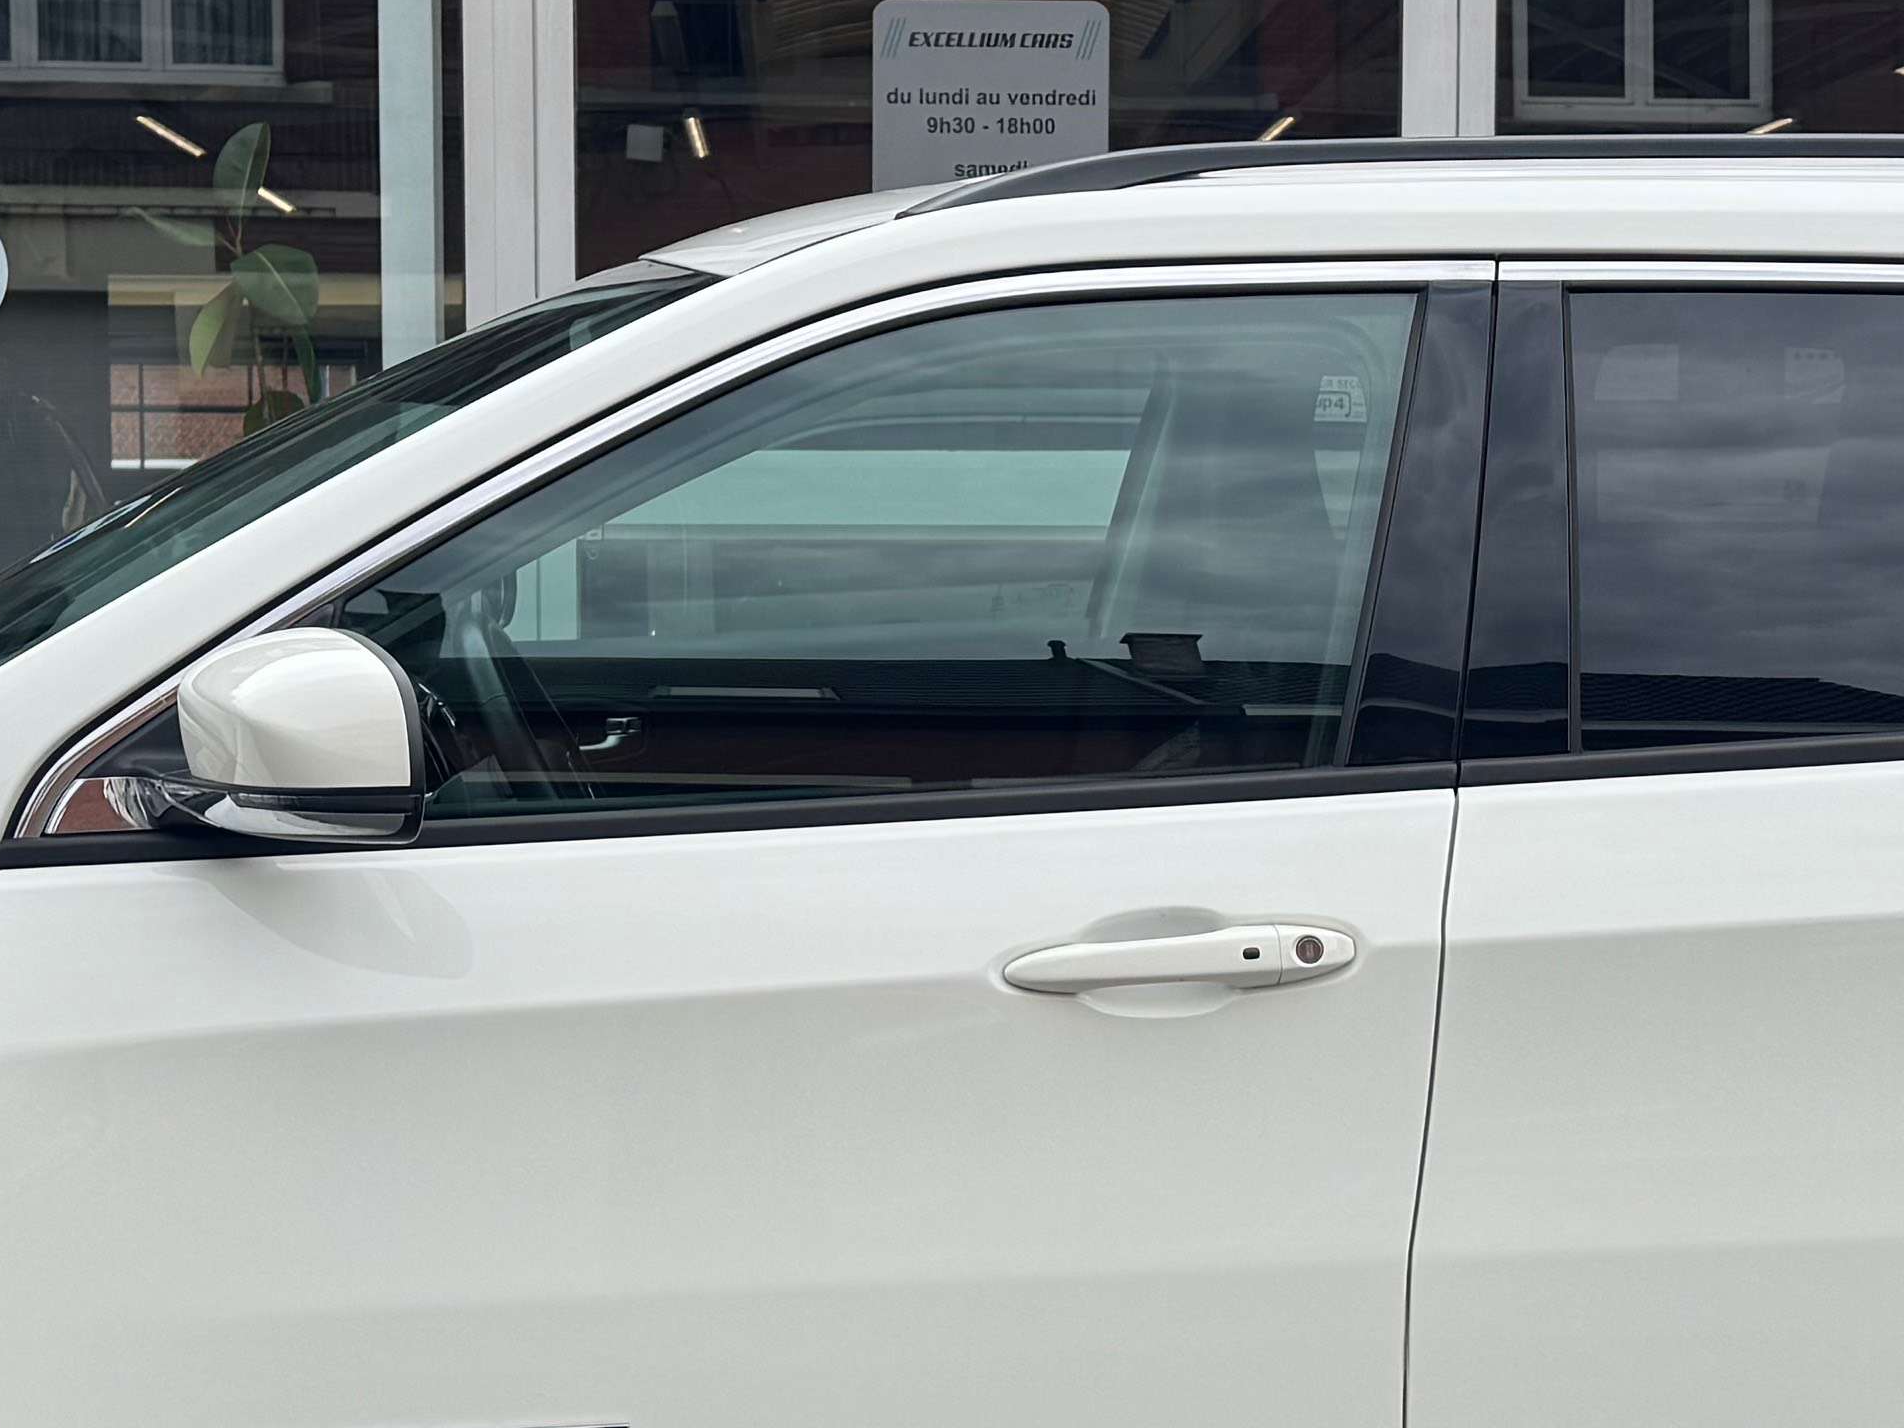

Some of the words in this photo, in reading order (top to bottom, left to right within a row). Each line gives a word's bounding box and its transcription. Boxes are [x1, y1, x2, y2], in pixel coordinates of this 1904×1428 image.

[908, 31, 1017, 49] EXCELLIUM
[1020, 33, 1075, 50] CARS
[886, 88, 912, 105] du
[919, 88, 970, 105] lundi
[976, 91, 1001, 106] au
[1007, 89, 1097, 106] vendredi
[926, 117, 976, 134] 9h30
[997, 117, 1056, 135] 18h00
